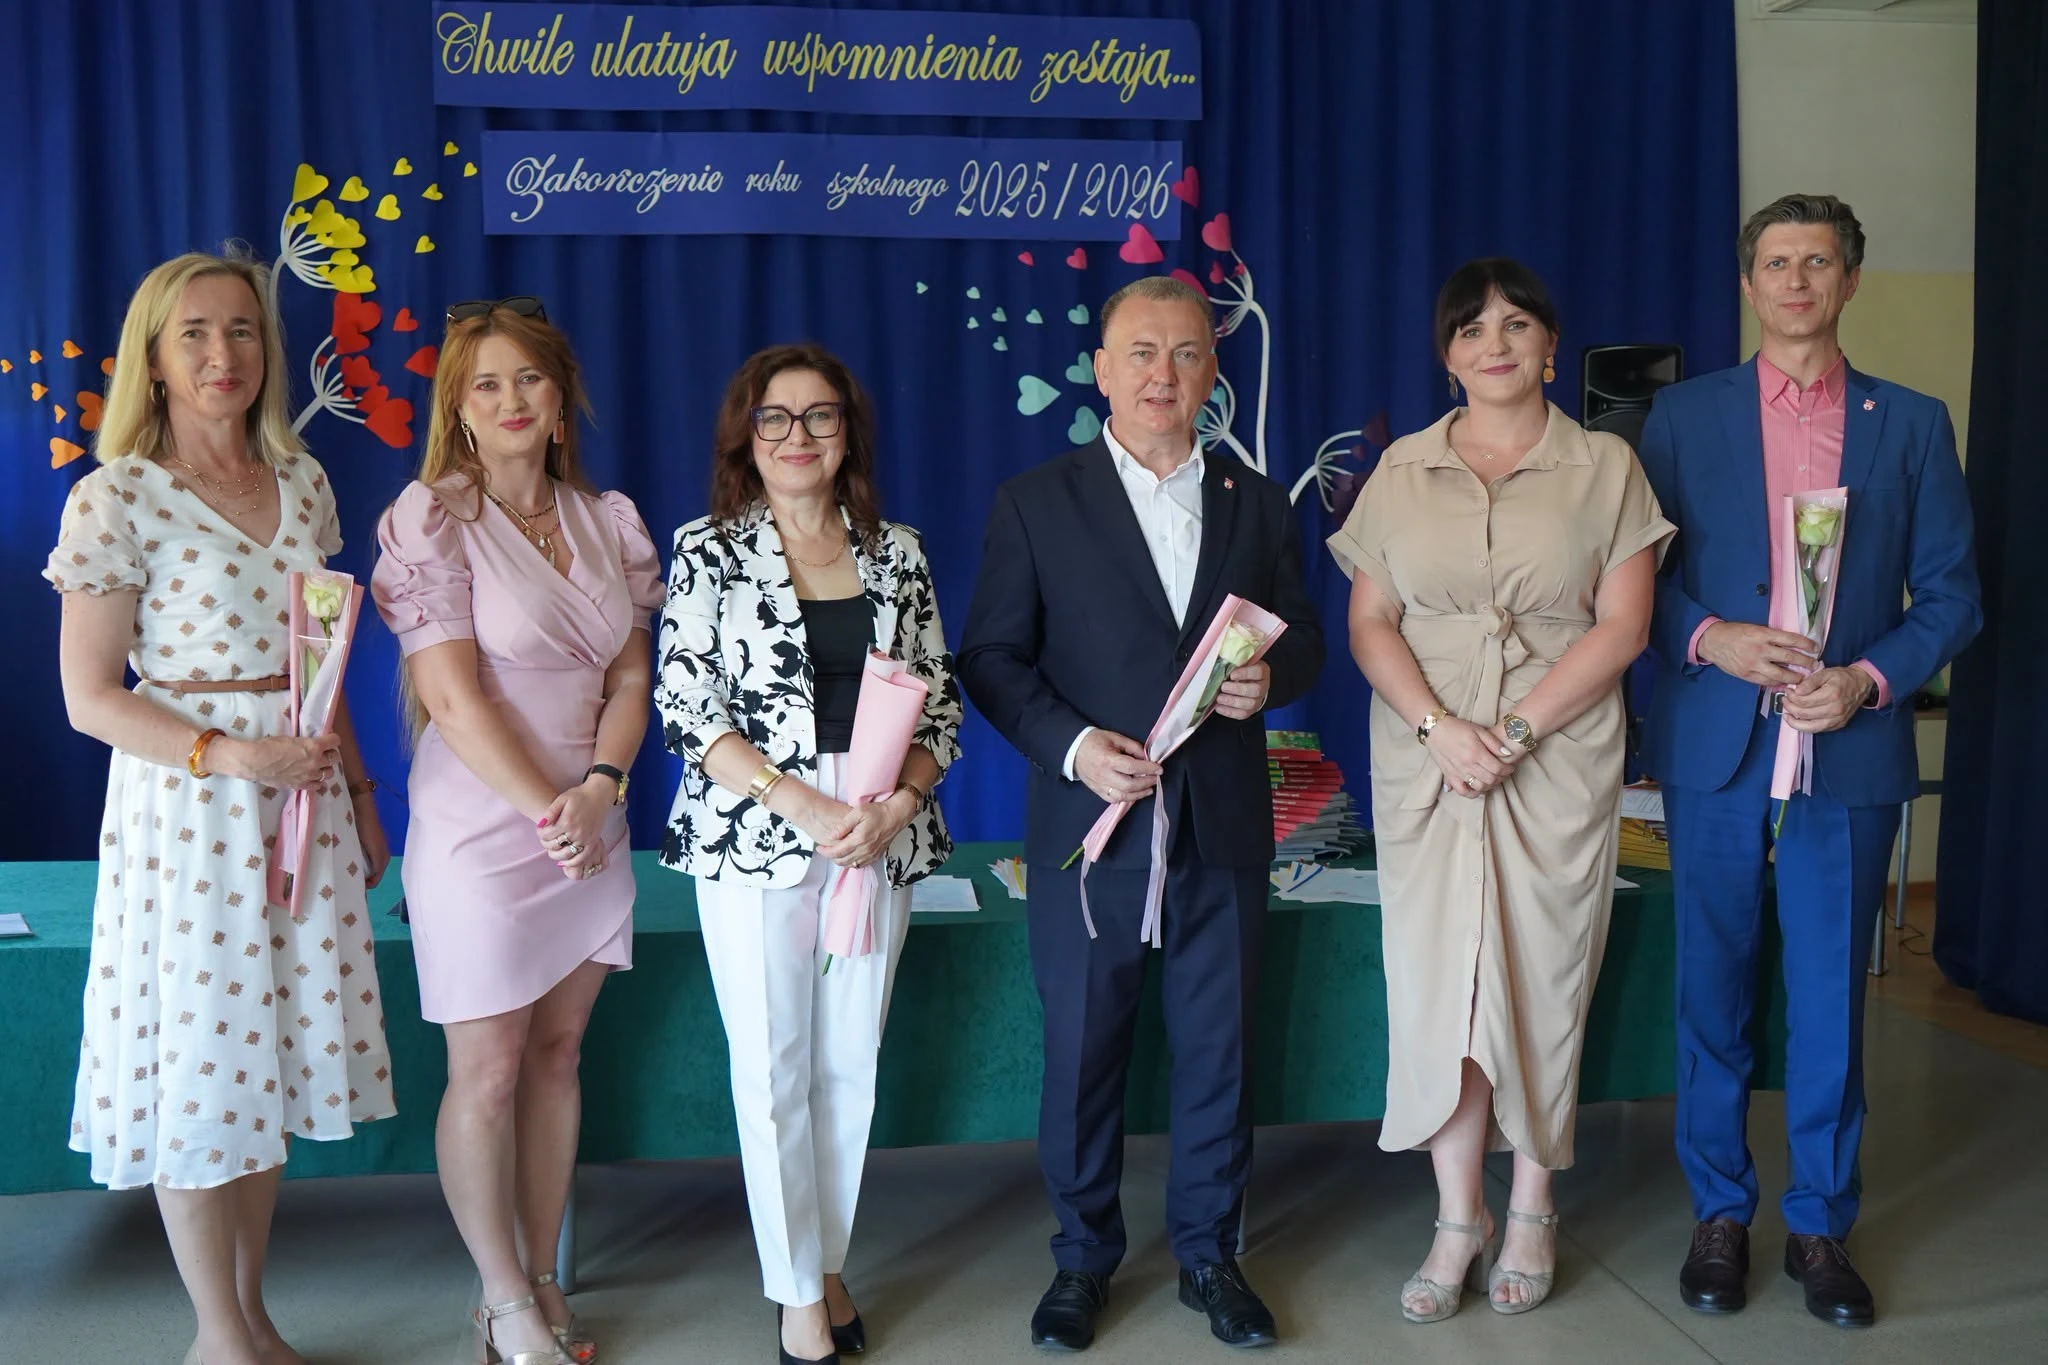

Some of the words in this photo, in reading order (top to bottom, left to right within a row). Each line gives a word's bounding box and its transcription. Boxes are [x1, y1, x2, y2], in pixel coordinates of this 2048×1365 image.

[436, 11, 575, 76] Chwile
[763, 32, 1022, 93] wspomnienia
[745, 159, 802, 193] roku
[826, 163, 949, 216] szkolnego
